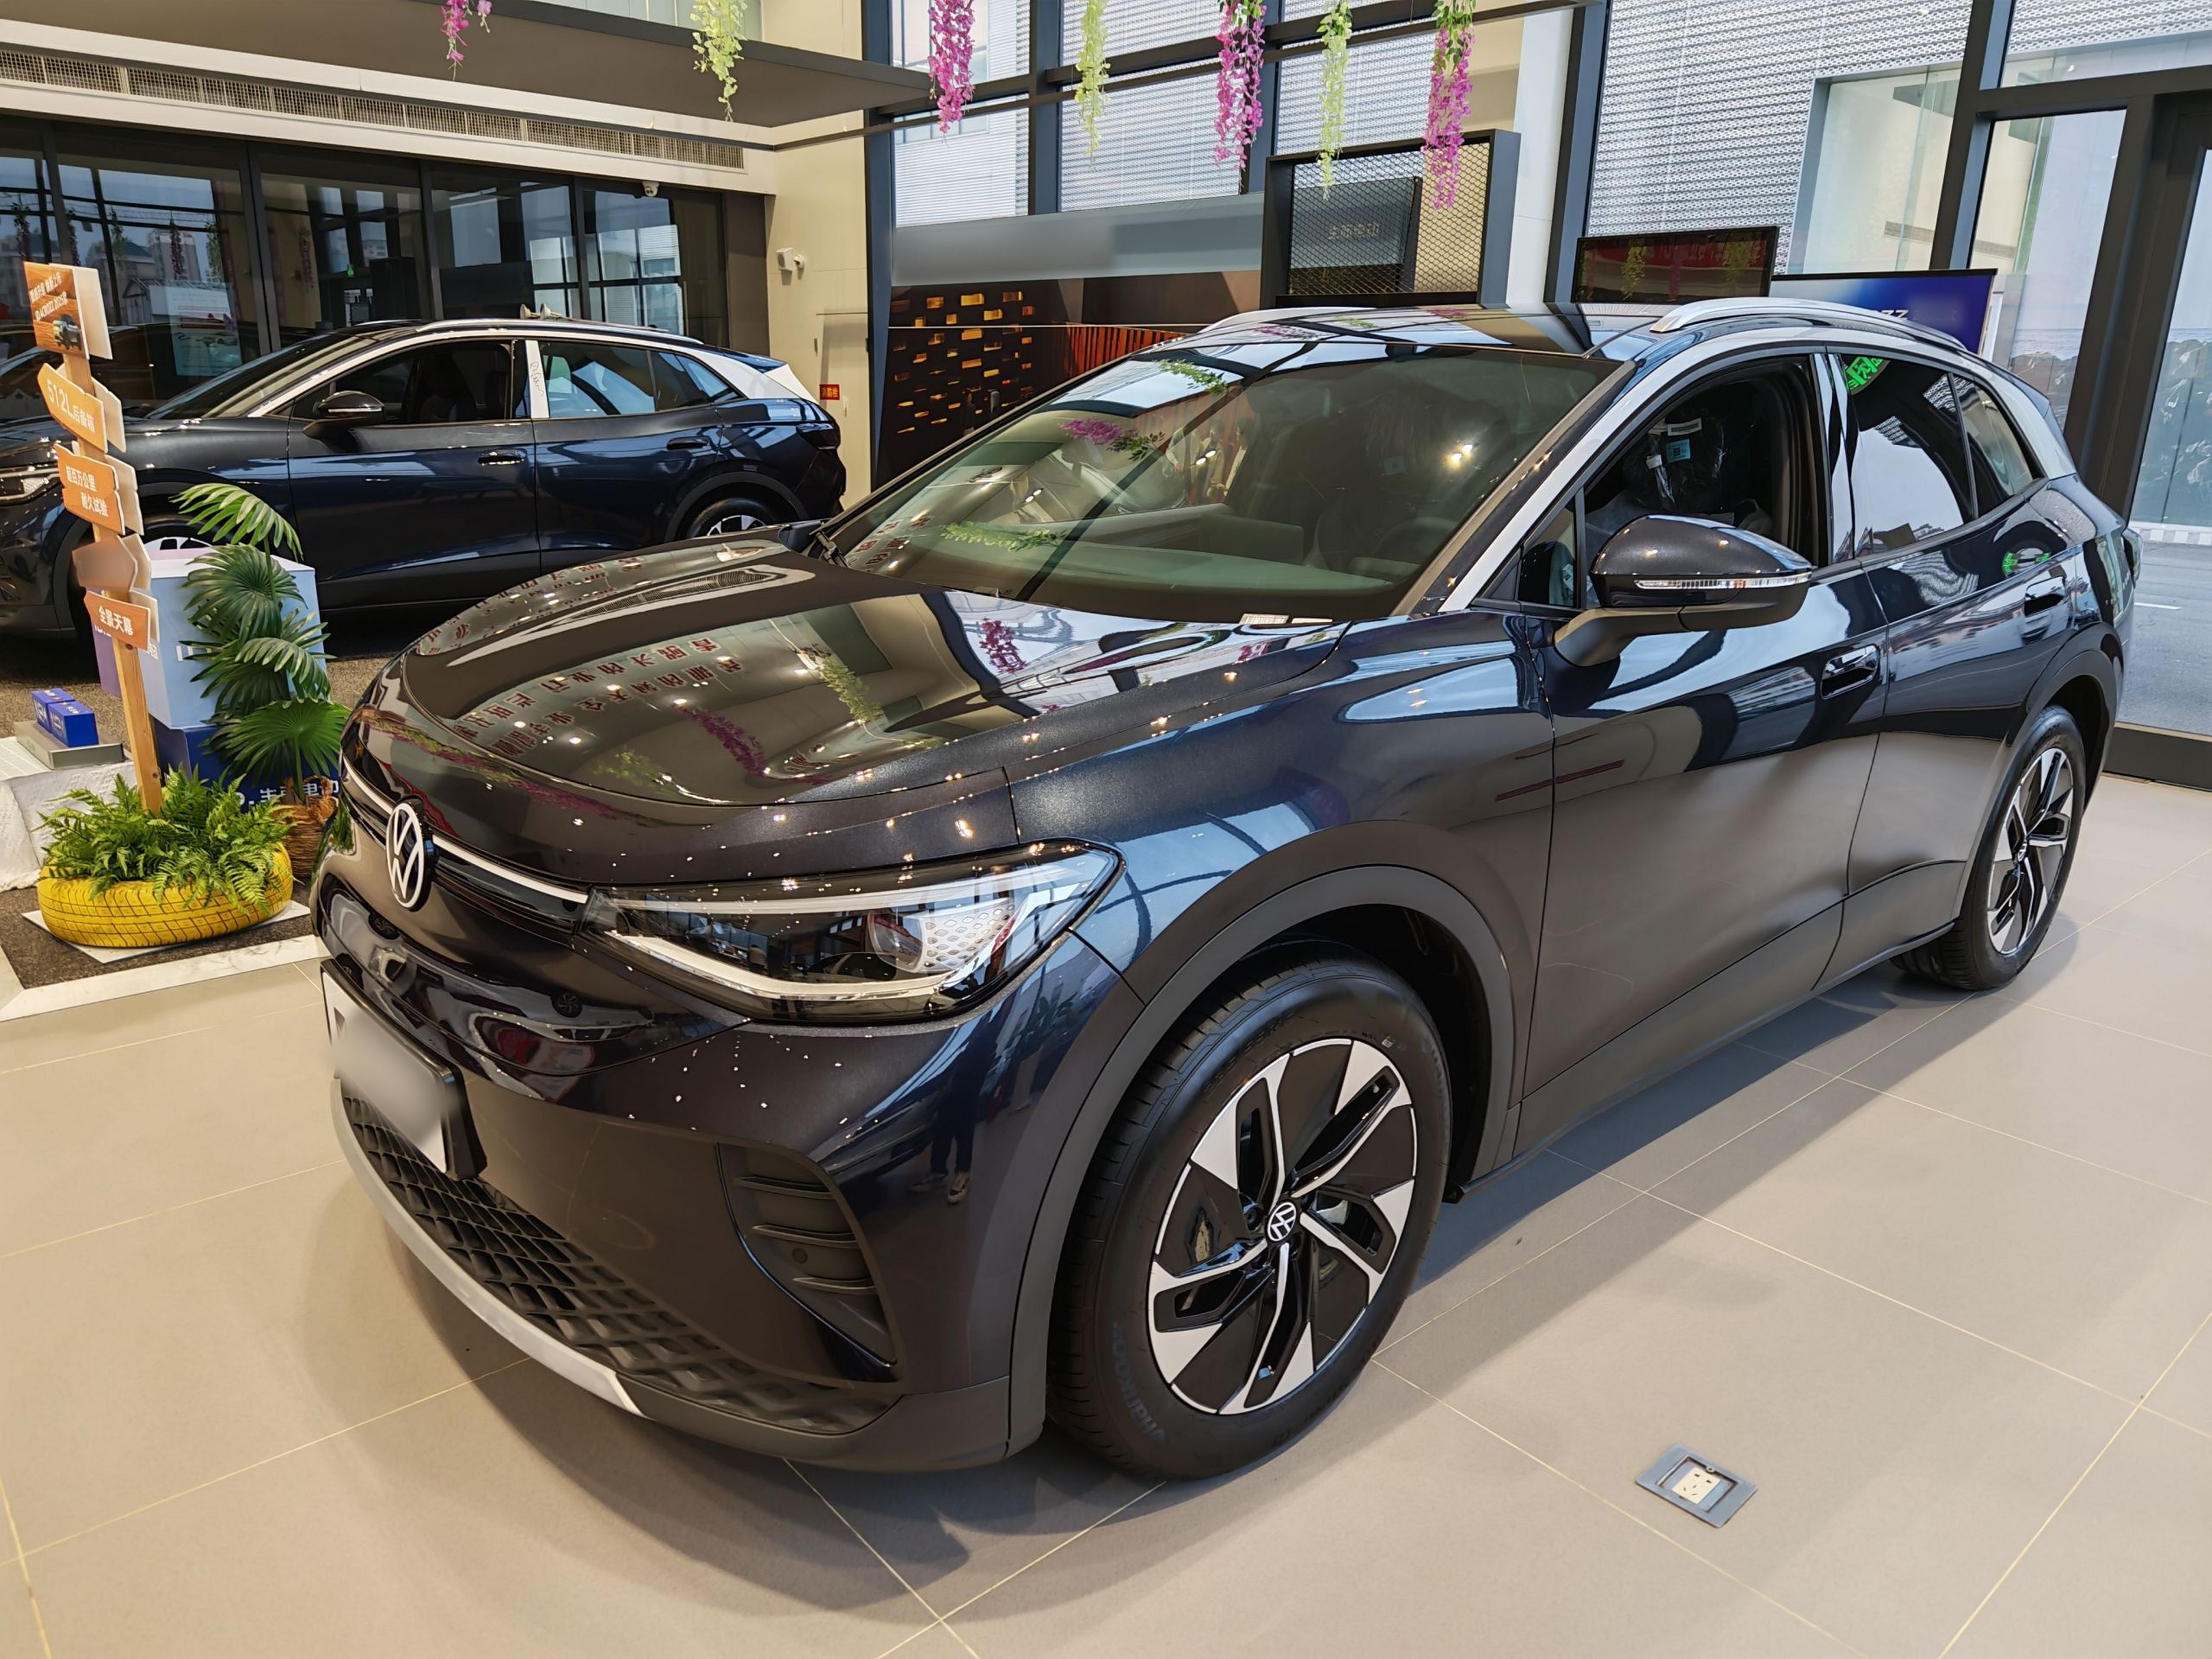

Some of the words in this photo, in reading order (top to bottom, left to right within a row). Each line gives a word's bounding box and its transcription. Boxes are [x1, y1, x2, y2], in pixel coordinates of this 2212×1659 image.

[66, 465, 97, 493] 超百万公里
[80, 491, 109, 517] 耐久试验
[98, 605, 134, 637] 全景天幕
